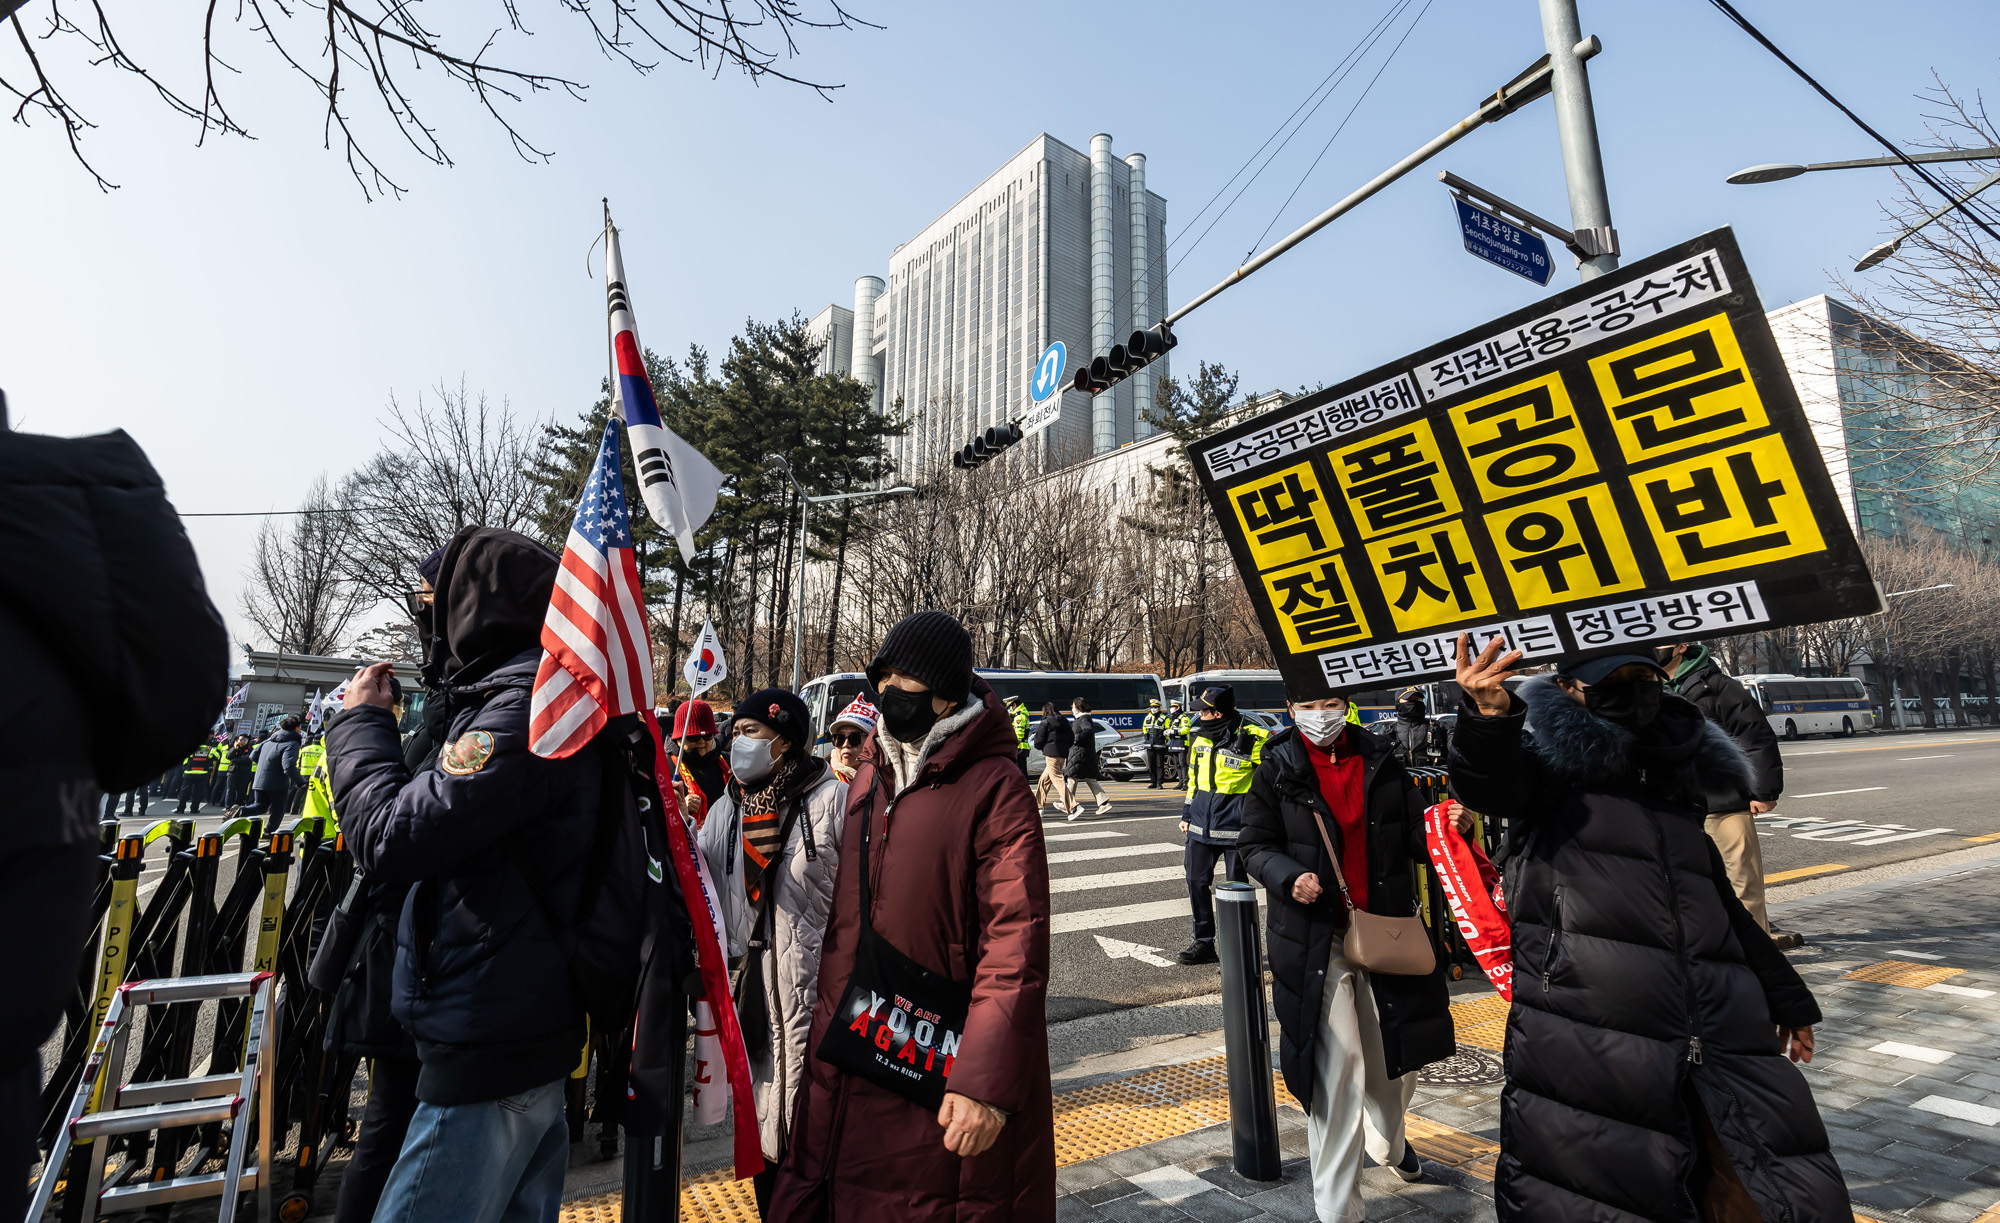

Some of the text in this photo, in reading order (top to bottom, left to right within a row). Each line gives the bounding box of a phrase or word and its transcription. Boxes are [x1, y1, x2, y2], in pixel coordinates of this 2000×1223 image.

[1465, 224, 1545, 267] Seochojungang-ro 160
[1471, 211, 1522, 245] 서초중앙로
[1026, 398, 1060, 430] 좌회전시
[1207, 377, 1417, 474] 특수공무집행방해
[1572, 586, 1756, 644] 정당방위
[1378, 711, 1399, 720] POLIC
[1433, 806, 1472, 903] MAKE KOREA GREAT
[95, 927, 121, 1027] POLICE
[869, 990, 962, 1058] YOON
[894, 994, 941, 1025] WE ARE
[875, 1053, 889, 1066] 12.3
[900, 1066, 923, 1081] RIGHT
